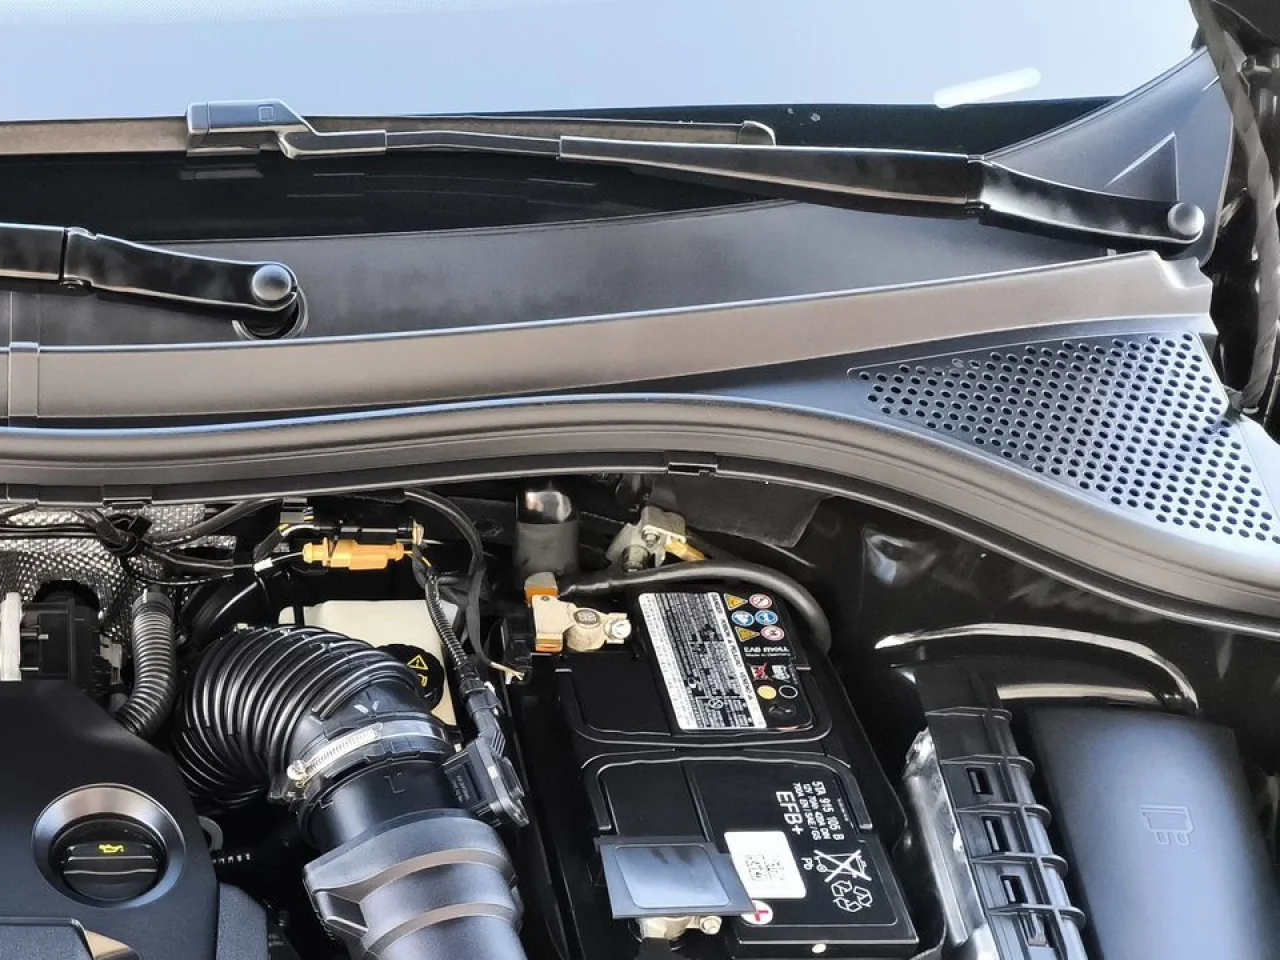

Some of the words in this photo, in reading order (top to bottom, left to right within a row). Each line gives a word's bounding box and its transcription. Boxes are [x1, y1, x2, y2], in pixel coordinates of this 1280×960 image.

[812, 781, 827, 796] 5TA
[819, 798, 834, 813] 915
[775, 791, 804, 836] EFB+
[801, 857, 814, 870] Pb
